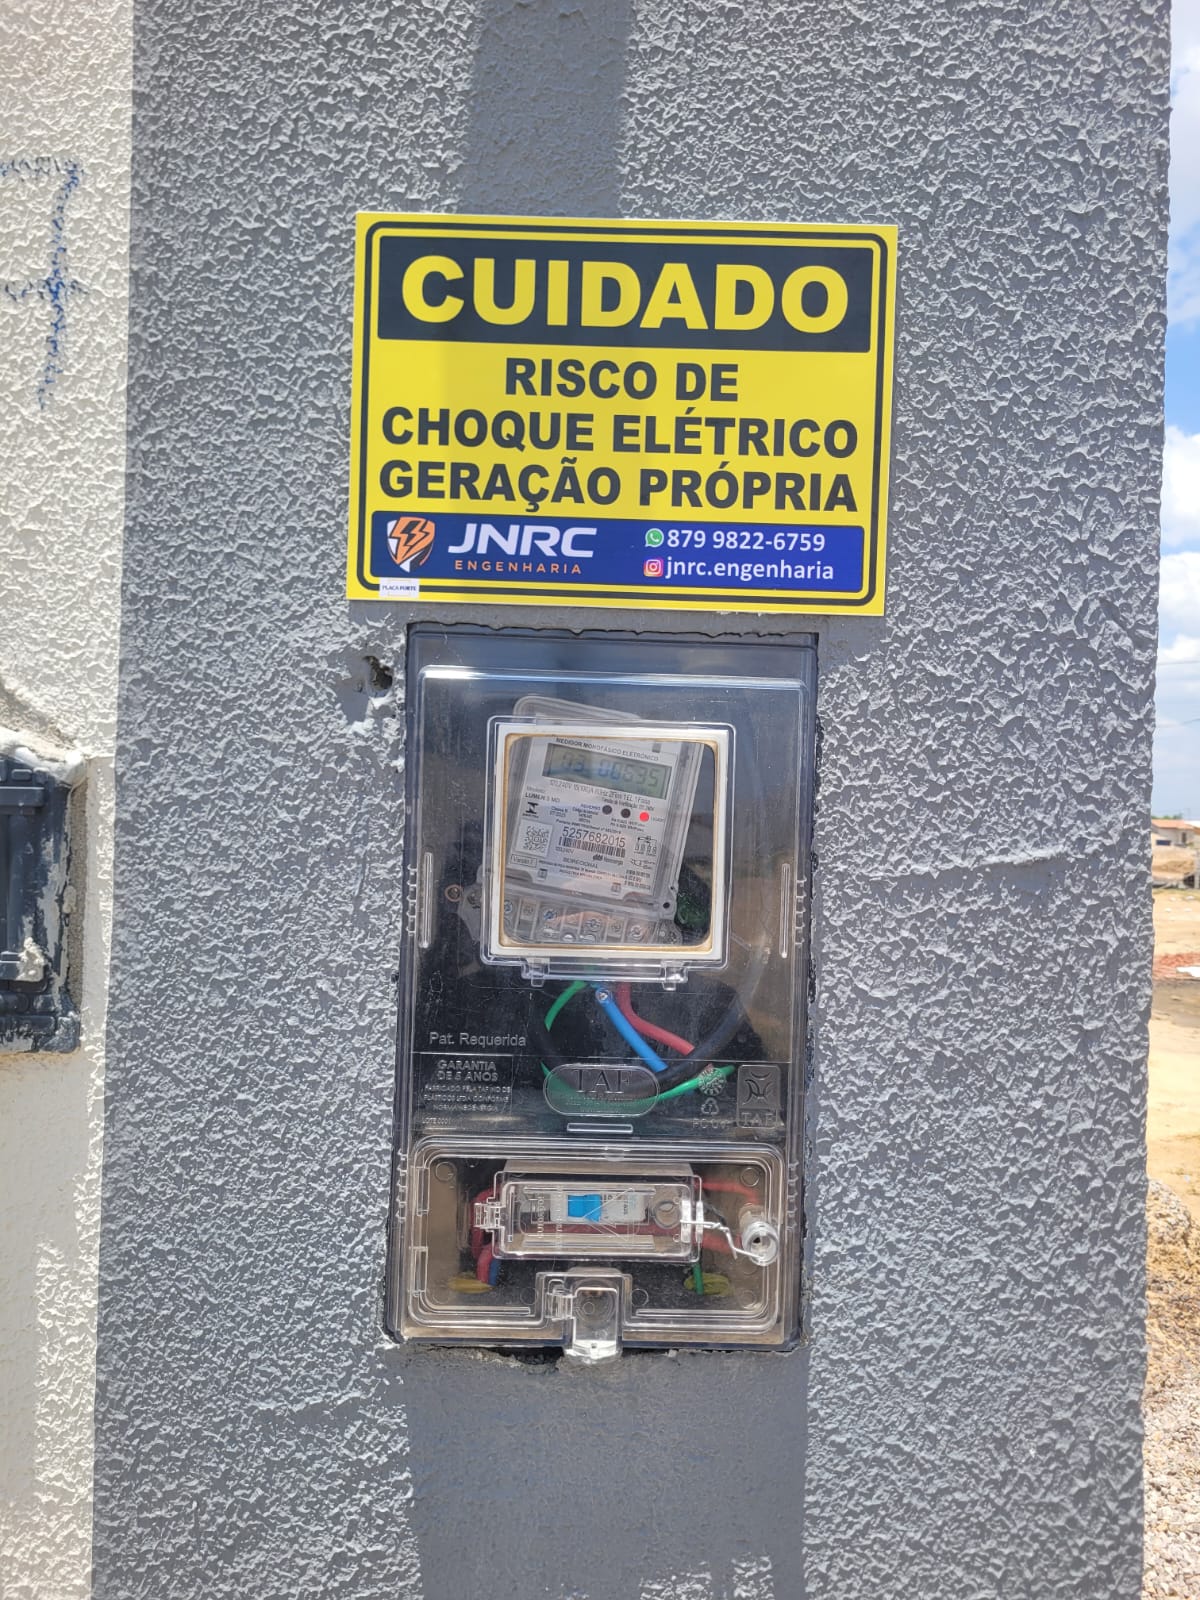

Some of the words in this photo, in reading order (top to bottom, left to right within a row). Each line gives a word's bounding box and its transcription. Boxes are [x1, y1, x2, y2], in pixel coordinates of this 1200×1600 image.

[401, 254, 849, 334] CUIDADO
[504, 357, 658, 400] RISCO
[675, 363, 739, 402] DE
[381, 407, 594, 452] CHOQUE
[612, 406, 859, 459] ELÉTRICO
[379, 457, 621, 512] GERAÇÃO
[638, 461, 859, 512] PRÓPRIA
[447, 522, 598, 558] JNRC
[667, 528, 708, 549] 879
[712, 530, 826, 552] 9822-6759
[454, 559, 582, 574] ENGENHARIA
[664, 557, 835, 582] jnrc.engenharia
[562, 825, 626, 848] 5257682015
[429, 1031, 455, 1045] Pat.
[459, 1032, 527, 1048] Requerida
[437, 1059, 497, 1071] GARANTIA
[437, 1070, 452, 1081] DE
[464, 1071, 499, 1082] ANOS
